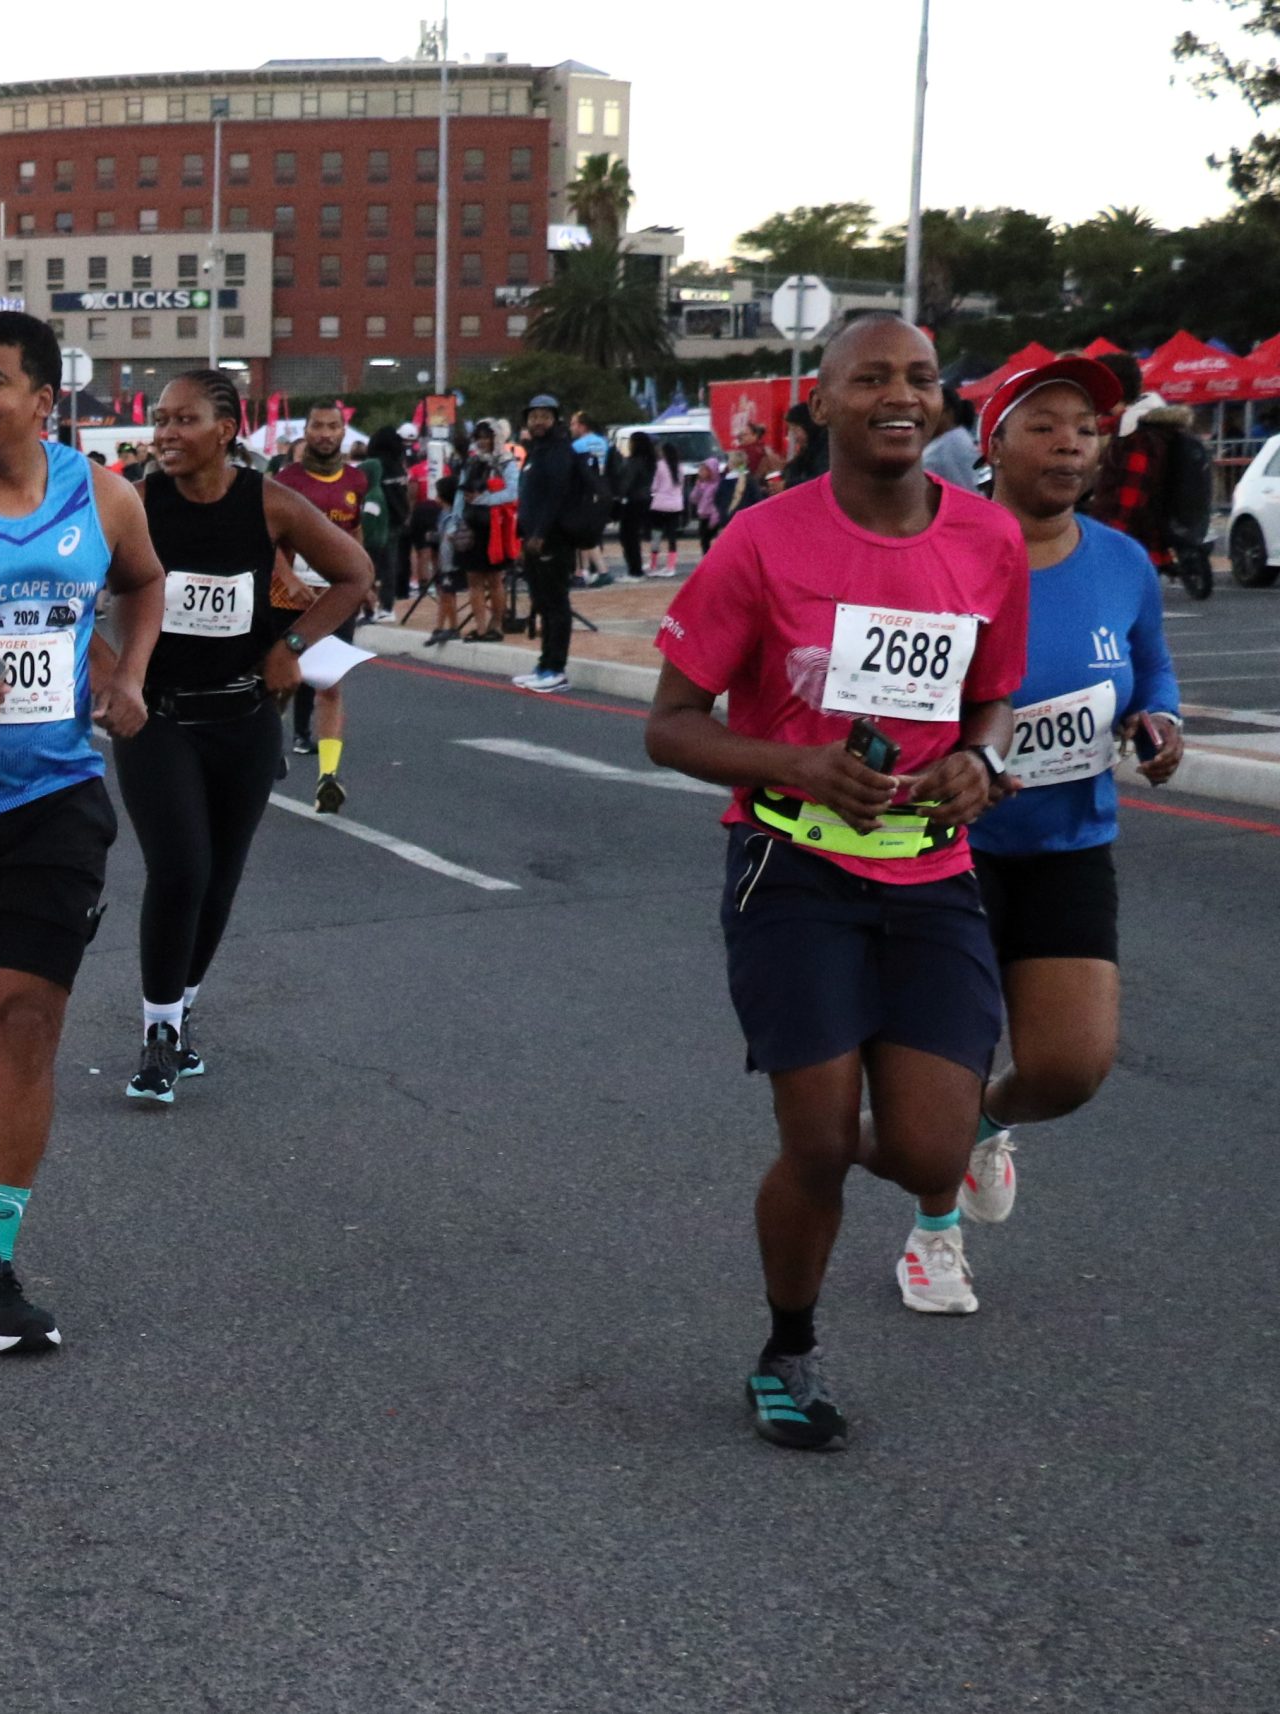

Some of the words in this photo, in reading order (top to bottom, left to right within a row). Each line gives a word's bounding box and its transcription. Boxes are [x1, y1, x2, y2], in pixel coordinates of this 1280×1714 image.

[102, 291, 191, 309] CLICKS
[11, 580, 50, 598] CAPE
[55, 581, 97, 598] TOWN
[183, 584, 236, 613] 3761
[14, 611, 39, 625] 2026
[50, 608, 75, 619] ASA
[869, 613, 913, 627] TYGER
[860, 627, 952, 680] 2688
[1014, 705, 1052, 718] TYGER
[1015, 706, 1095, 755] 2080
